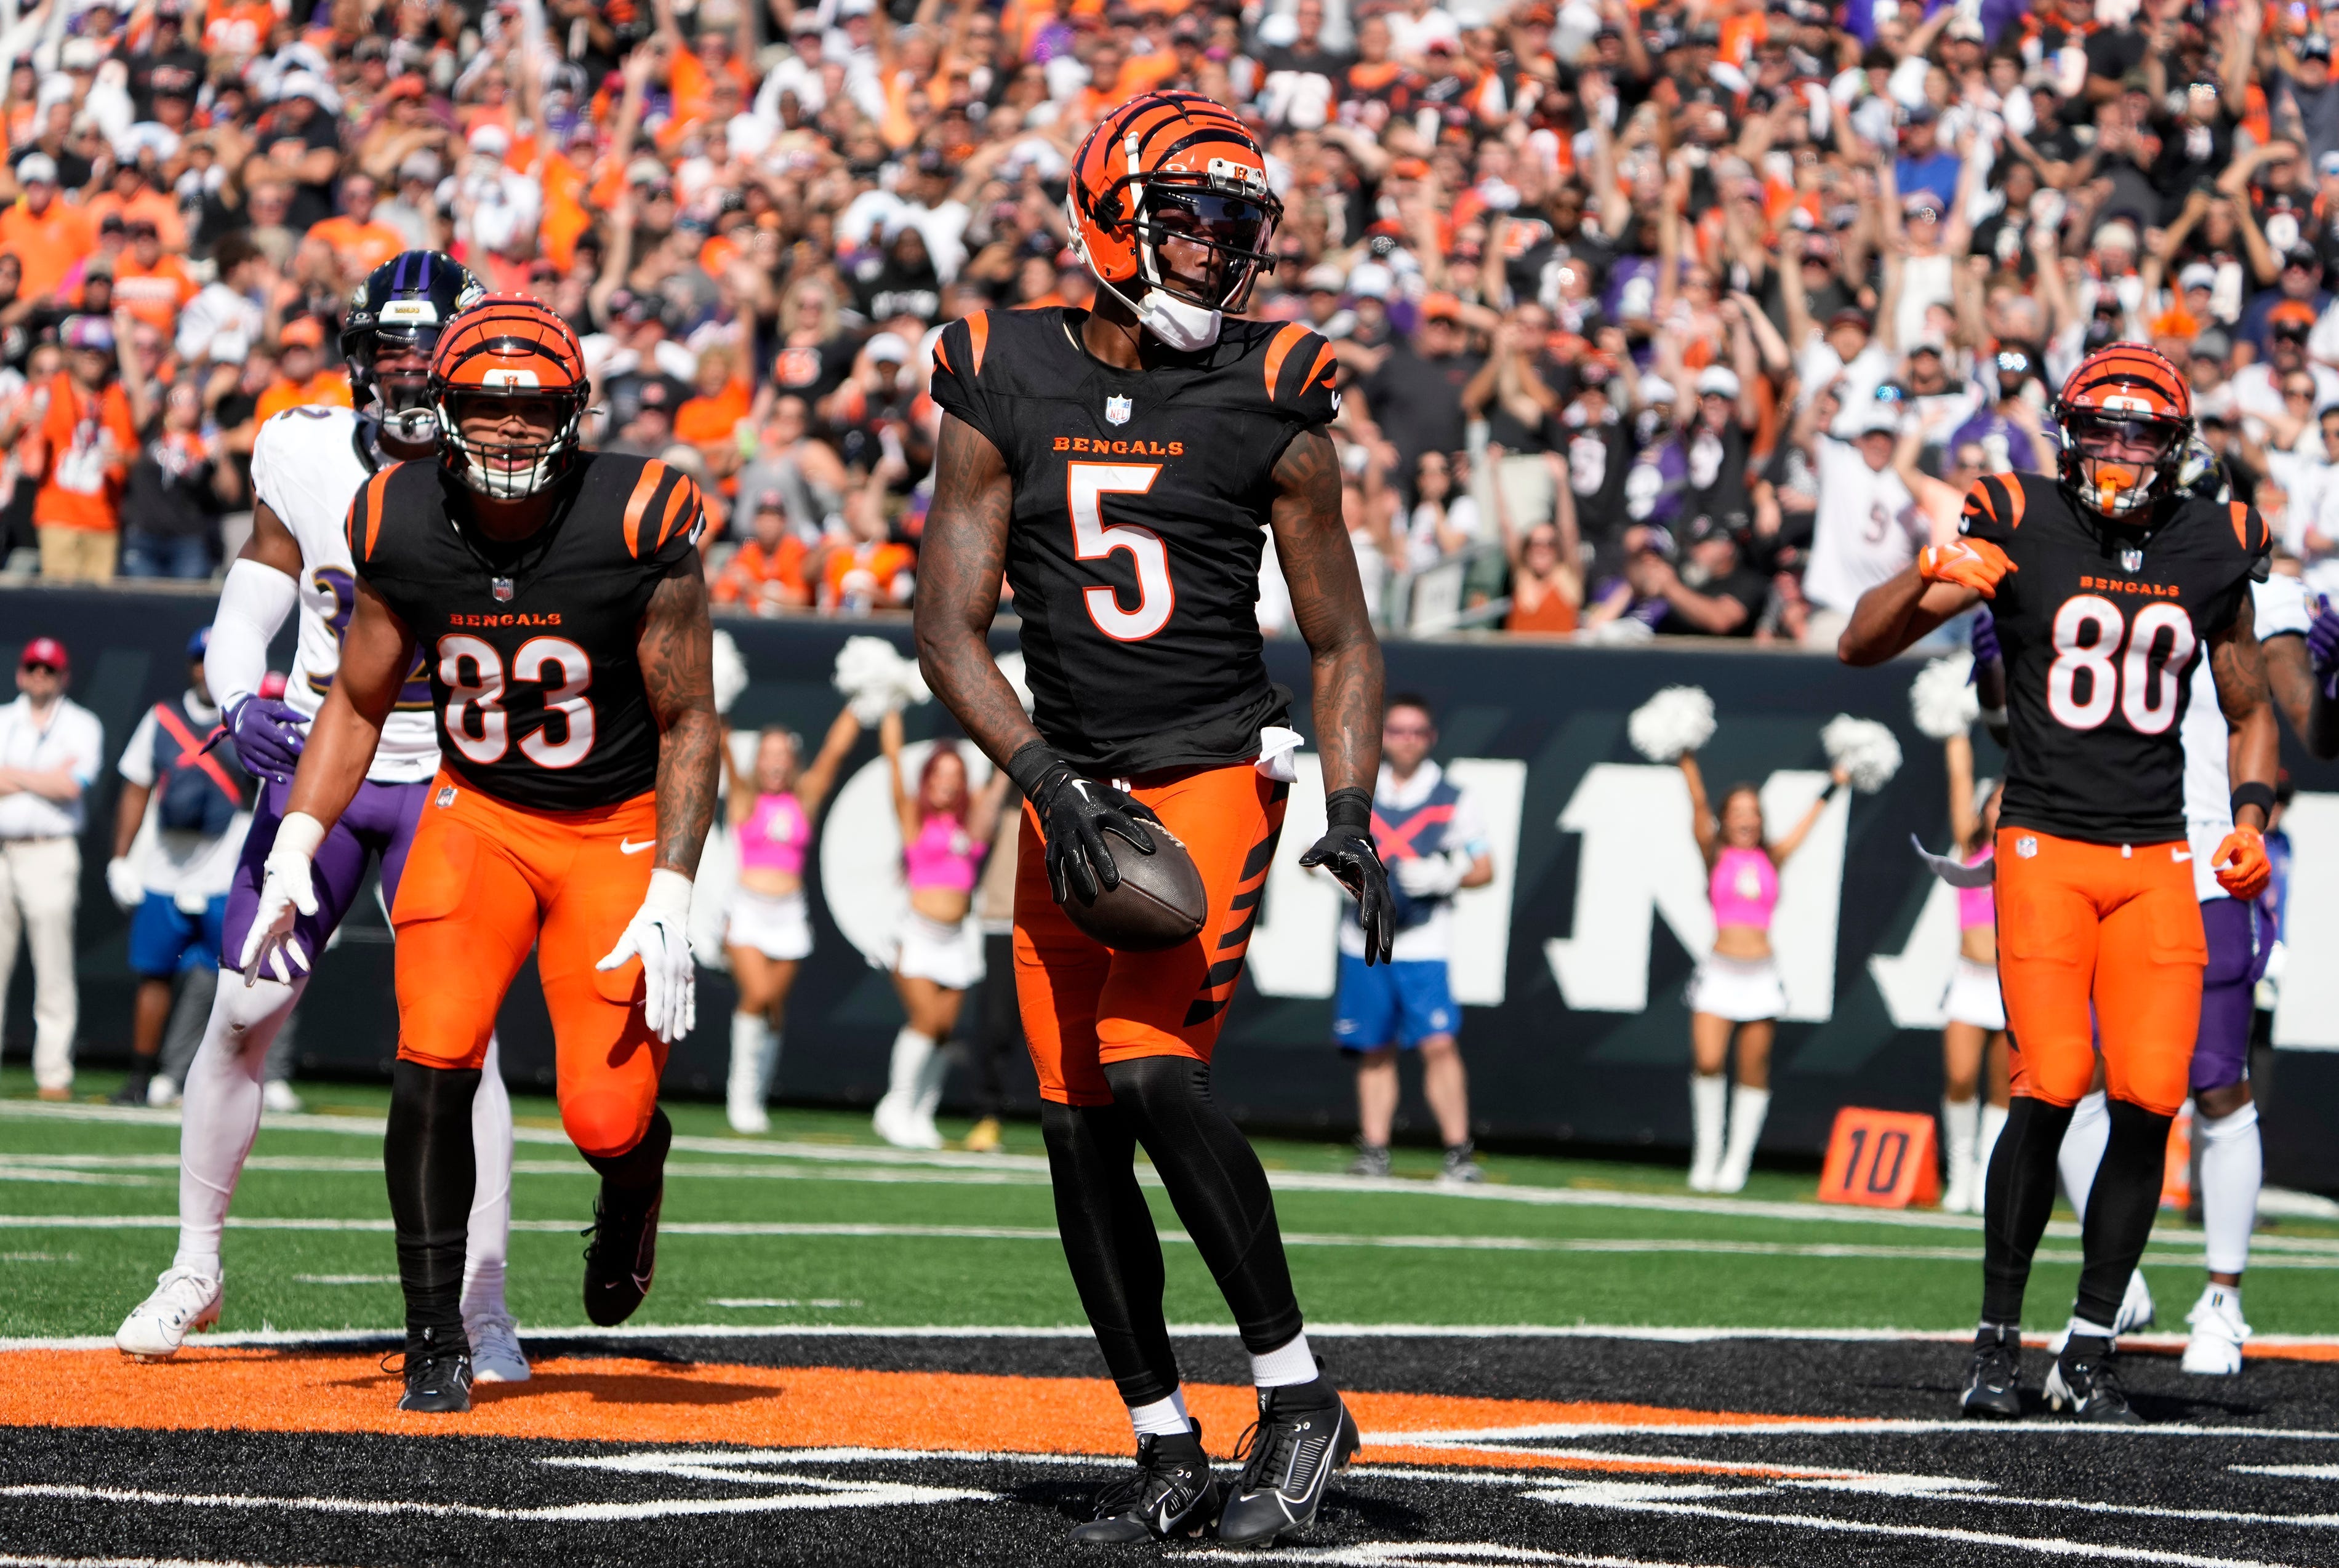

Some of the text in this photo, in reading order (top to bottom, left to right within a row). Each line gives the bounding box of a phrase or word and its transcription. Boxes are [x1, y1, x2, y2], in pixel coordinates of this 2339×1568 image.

[1053, 437, 1184, 456] BENGALS
[1066, 460, 1176, 642] 5
[449, 613, 562, 626] BENGALS
[2079, 575, 2180, 598] BENGALS
[2047, 593, 2196, 734] 80
[436, 633, 596, 769] 83
[1844, 1128, 1910, 1194] 10
